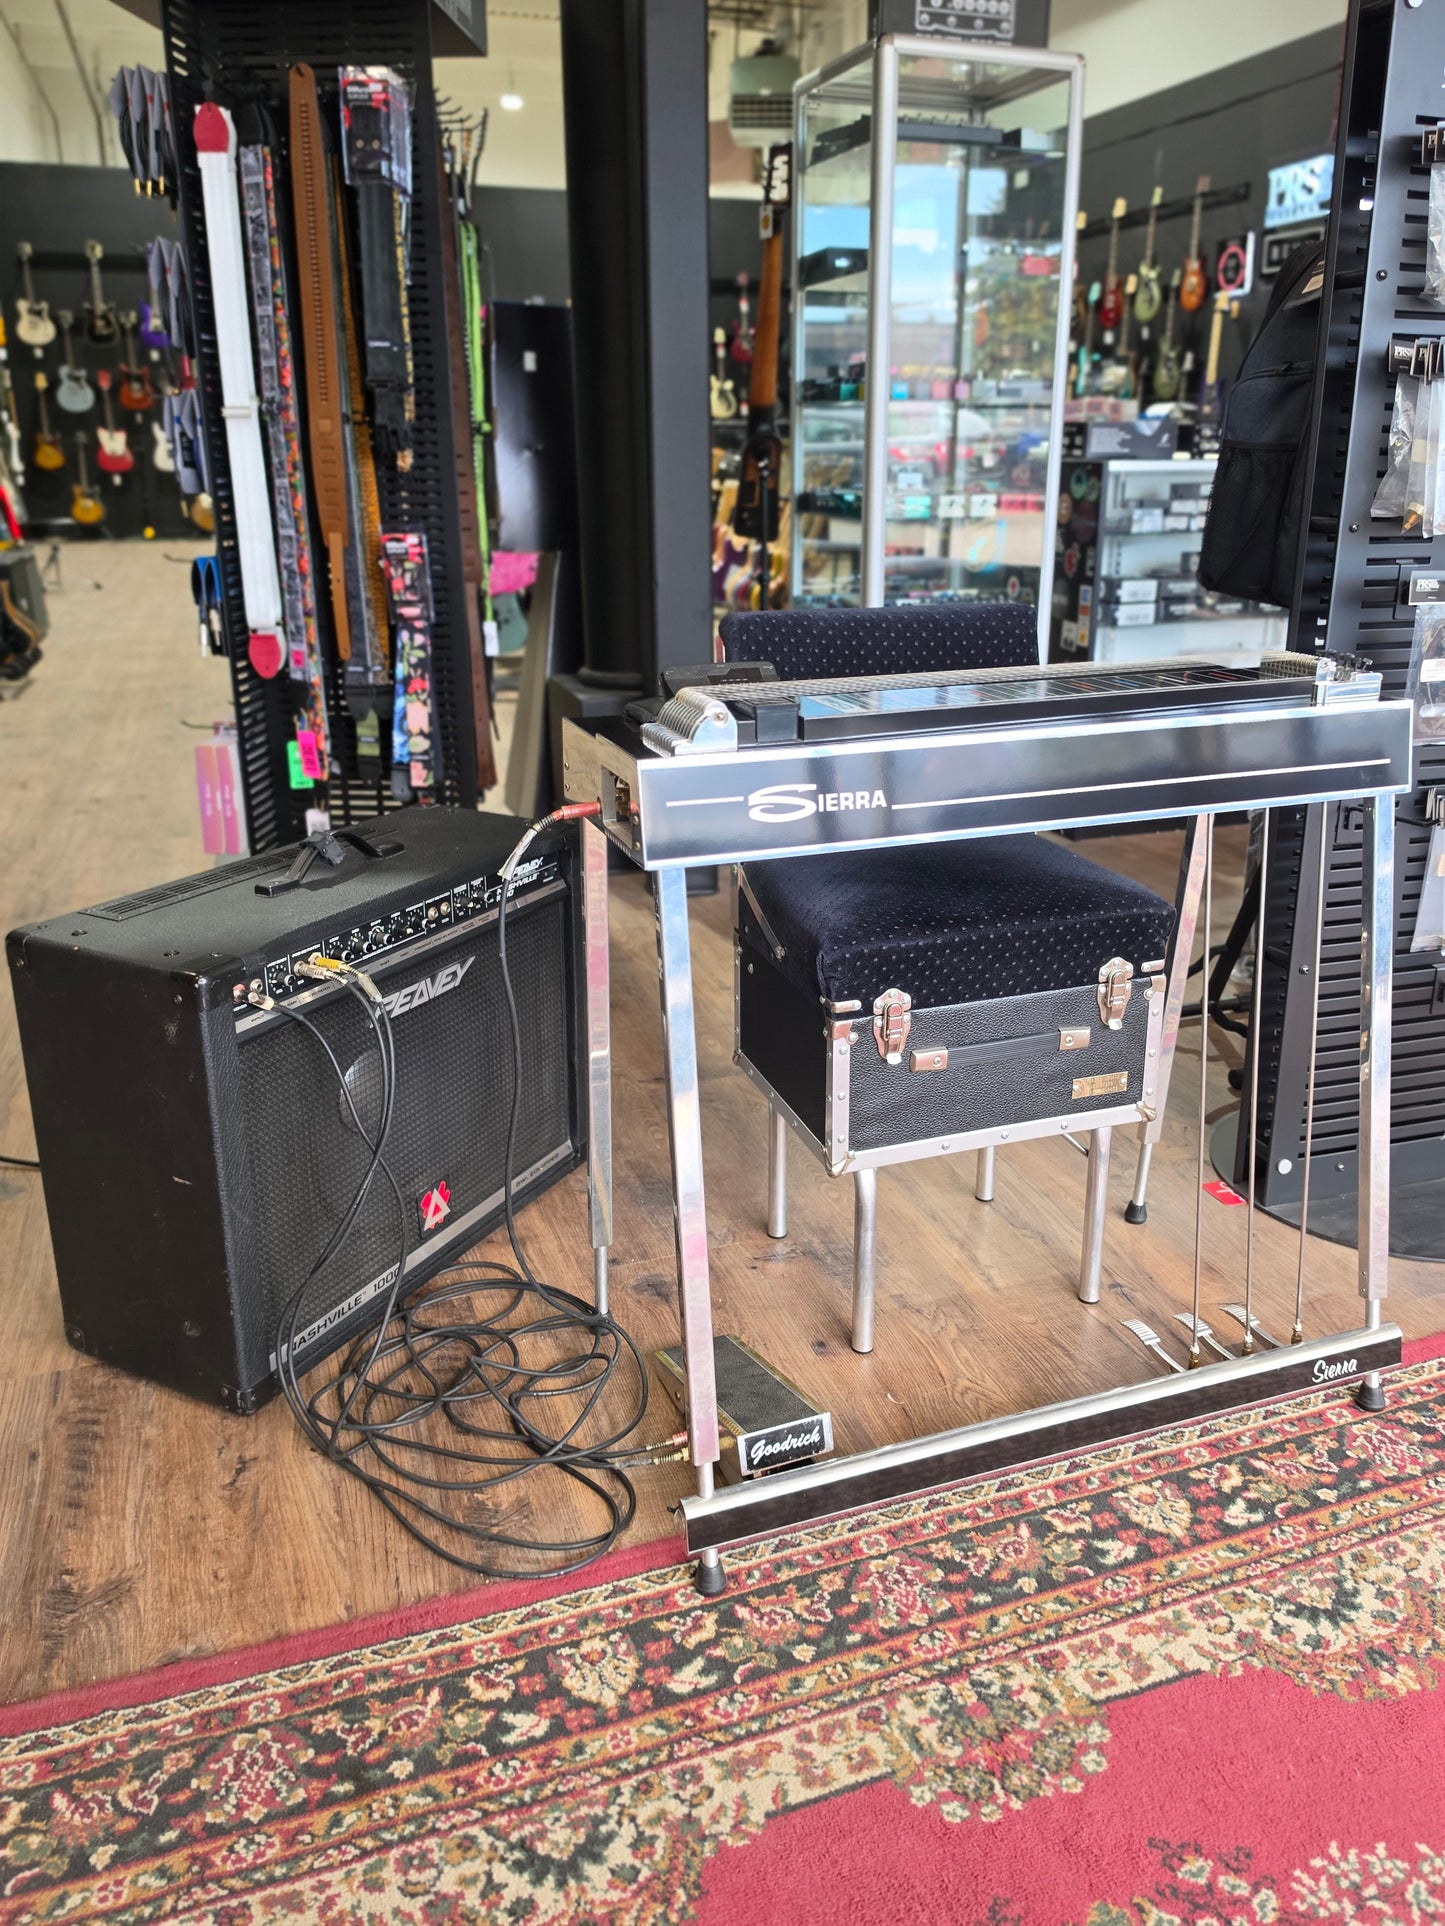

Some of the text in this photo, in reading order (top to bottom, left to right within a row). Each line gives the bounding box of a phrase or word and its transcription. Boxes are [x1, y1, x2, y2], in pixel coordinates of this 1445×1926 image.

[748, 784, 887, 823] SIERRA
[1312, 1359, 1357, 1383] Sierra
[751, 1425, 821, 1465] Goodrich
